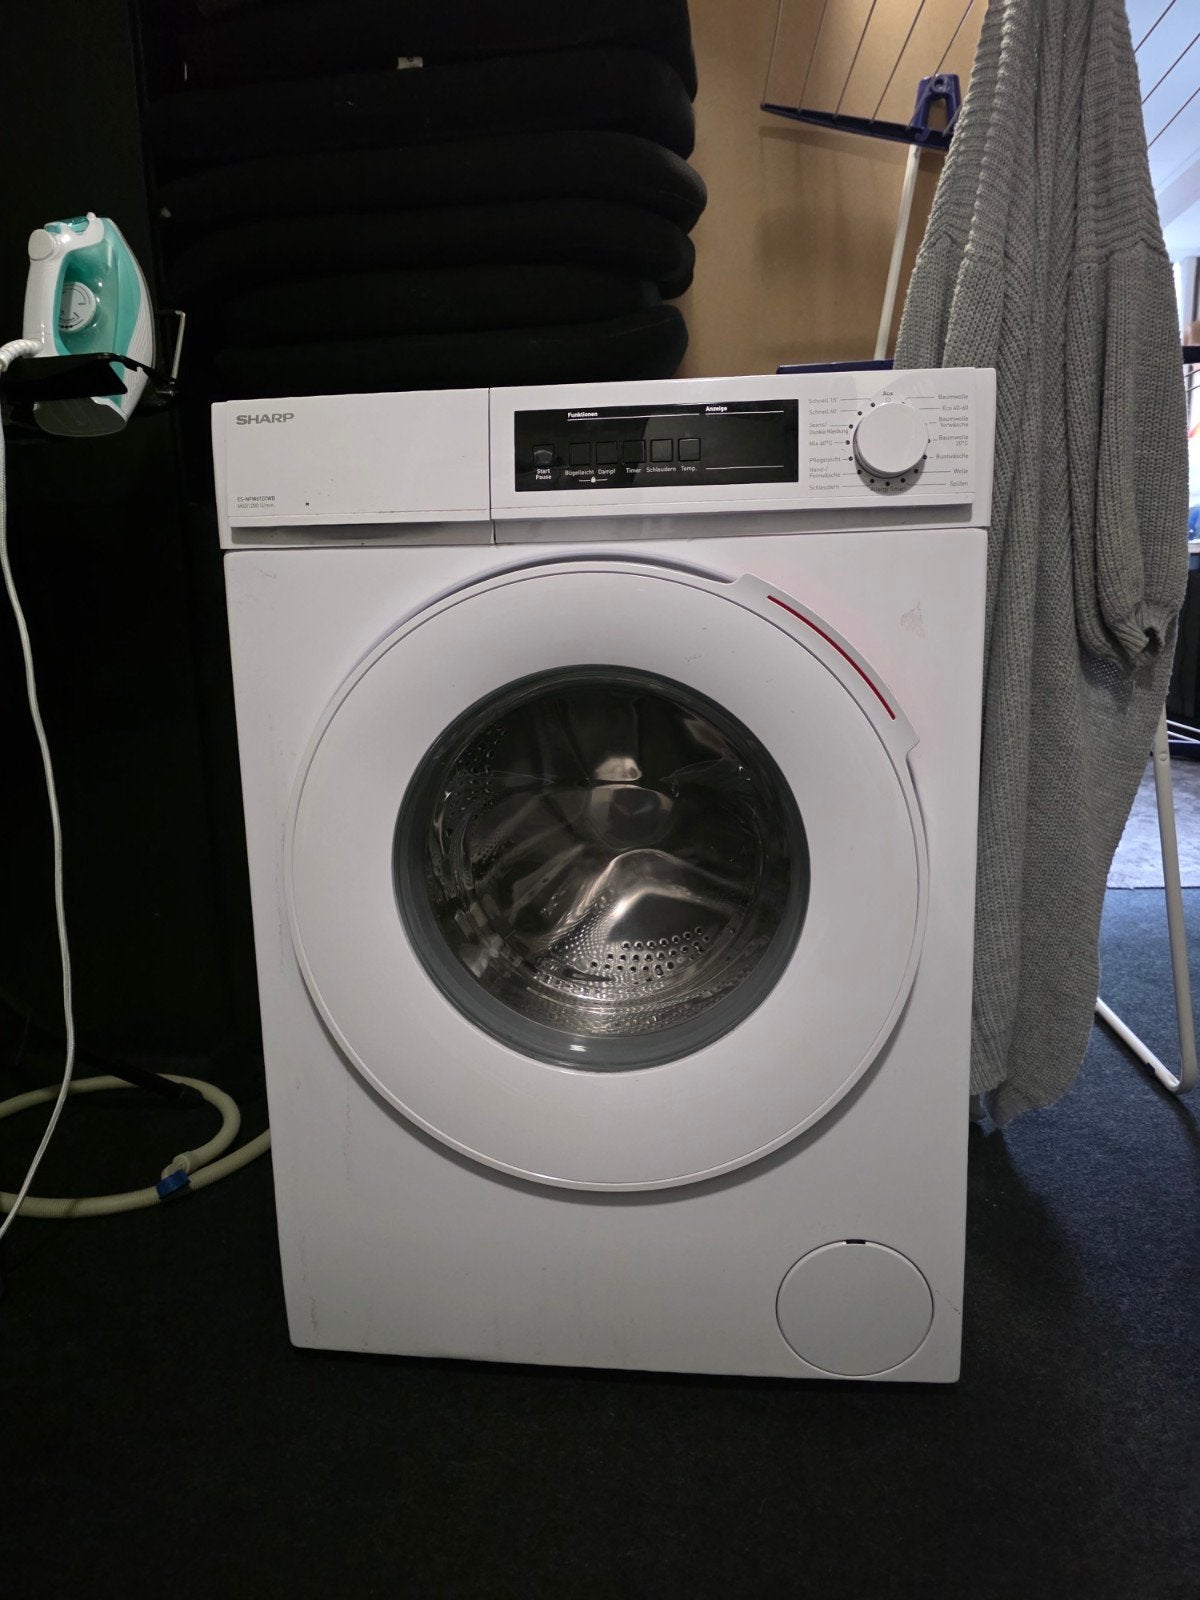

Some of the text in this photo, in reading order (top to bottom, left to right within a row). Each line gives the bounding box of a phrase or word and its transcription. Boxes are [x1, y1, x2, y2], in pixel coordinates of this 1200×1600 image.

[236, 412, 295, 425] SHARP
[564, 468, 595, 477] Bügelleicht
[597, 467, 616, 476] Dampf
[625, 466, 642, 474] Timer
[646, 465, 677, 473] Schleudern
[681, 464, 698, 473] Temp.
